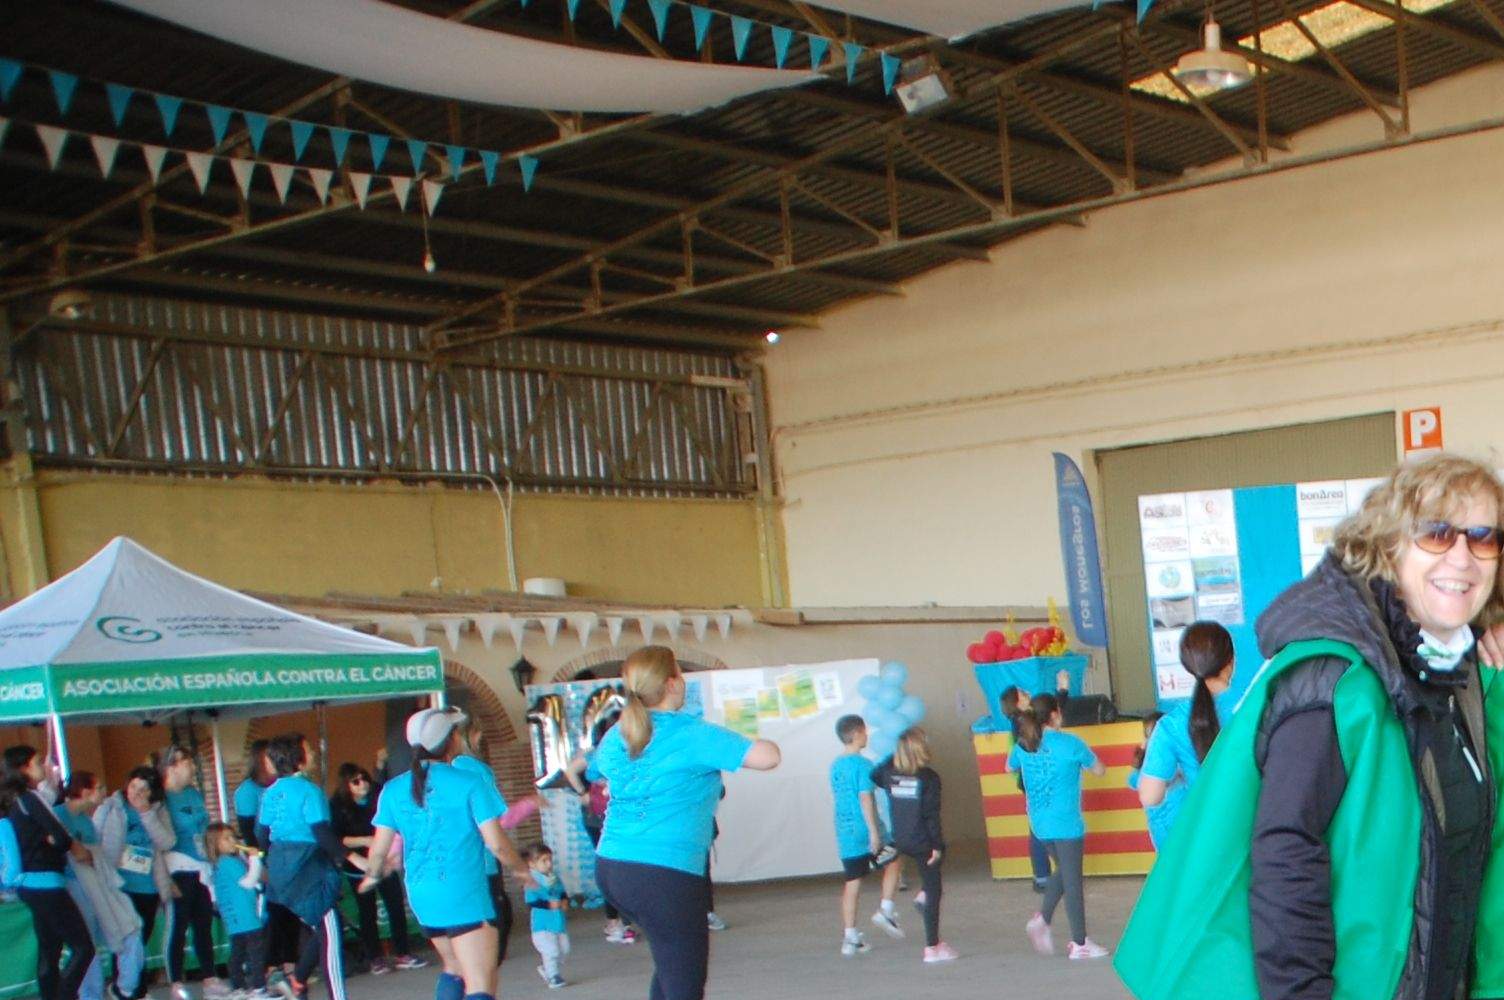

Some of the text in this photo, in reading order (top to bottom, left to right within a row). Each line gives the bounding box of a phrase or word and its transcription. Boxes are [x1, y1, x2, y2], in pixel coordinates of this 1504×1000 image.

[1410, 411, 1437, 448] P
[63, 663, 437, 698] ASOCIACIÓN ESPAÑOLA CONTRA EL CÁNCER
